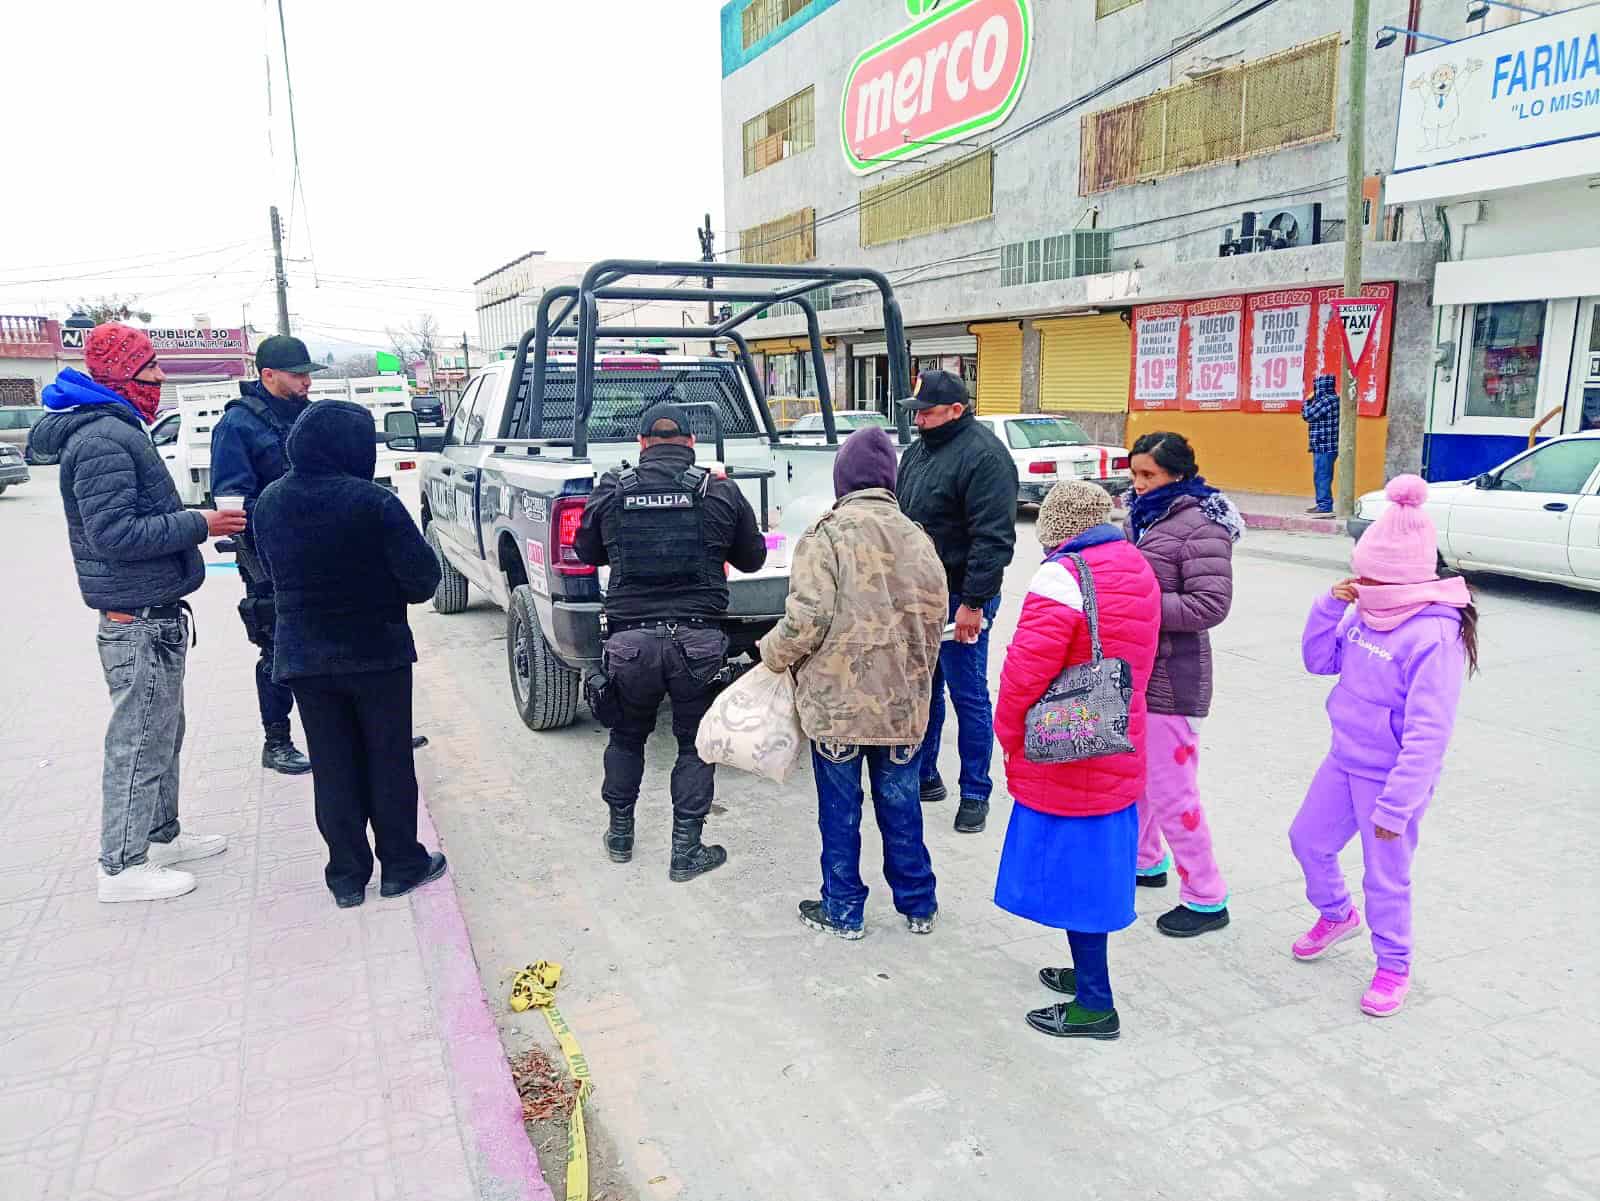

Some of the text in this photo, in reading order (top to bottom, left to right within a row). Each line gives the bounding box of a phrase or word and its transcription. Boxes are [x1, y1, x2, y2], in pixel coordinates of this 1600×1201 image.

[1491, 32, 1600, 100] FARMA
[854, 15, 1009, 143] merco
[1250, 290, 1312, 310] PRECIAZO
[1319, 285, 1390, 304] PREAZO
[1141, 321, 1176, 334] AGUACATE
[1200, 316, 1235, 335] HUEVO
[1262, 311, 1300, 330] FRIJOL
[1341, 314, 1371, 329] TAXI
[149, 329, 228, 339] PUBLICA 30
[1264, 329, 1295, 345] PINTO
[626, 494, 690, 507] POLICIA
